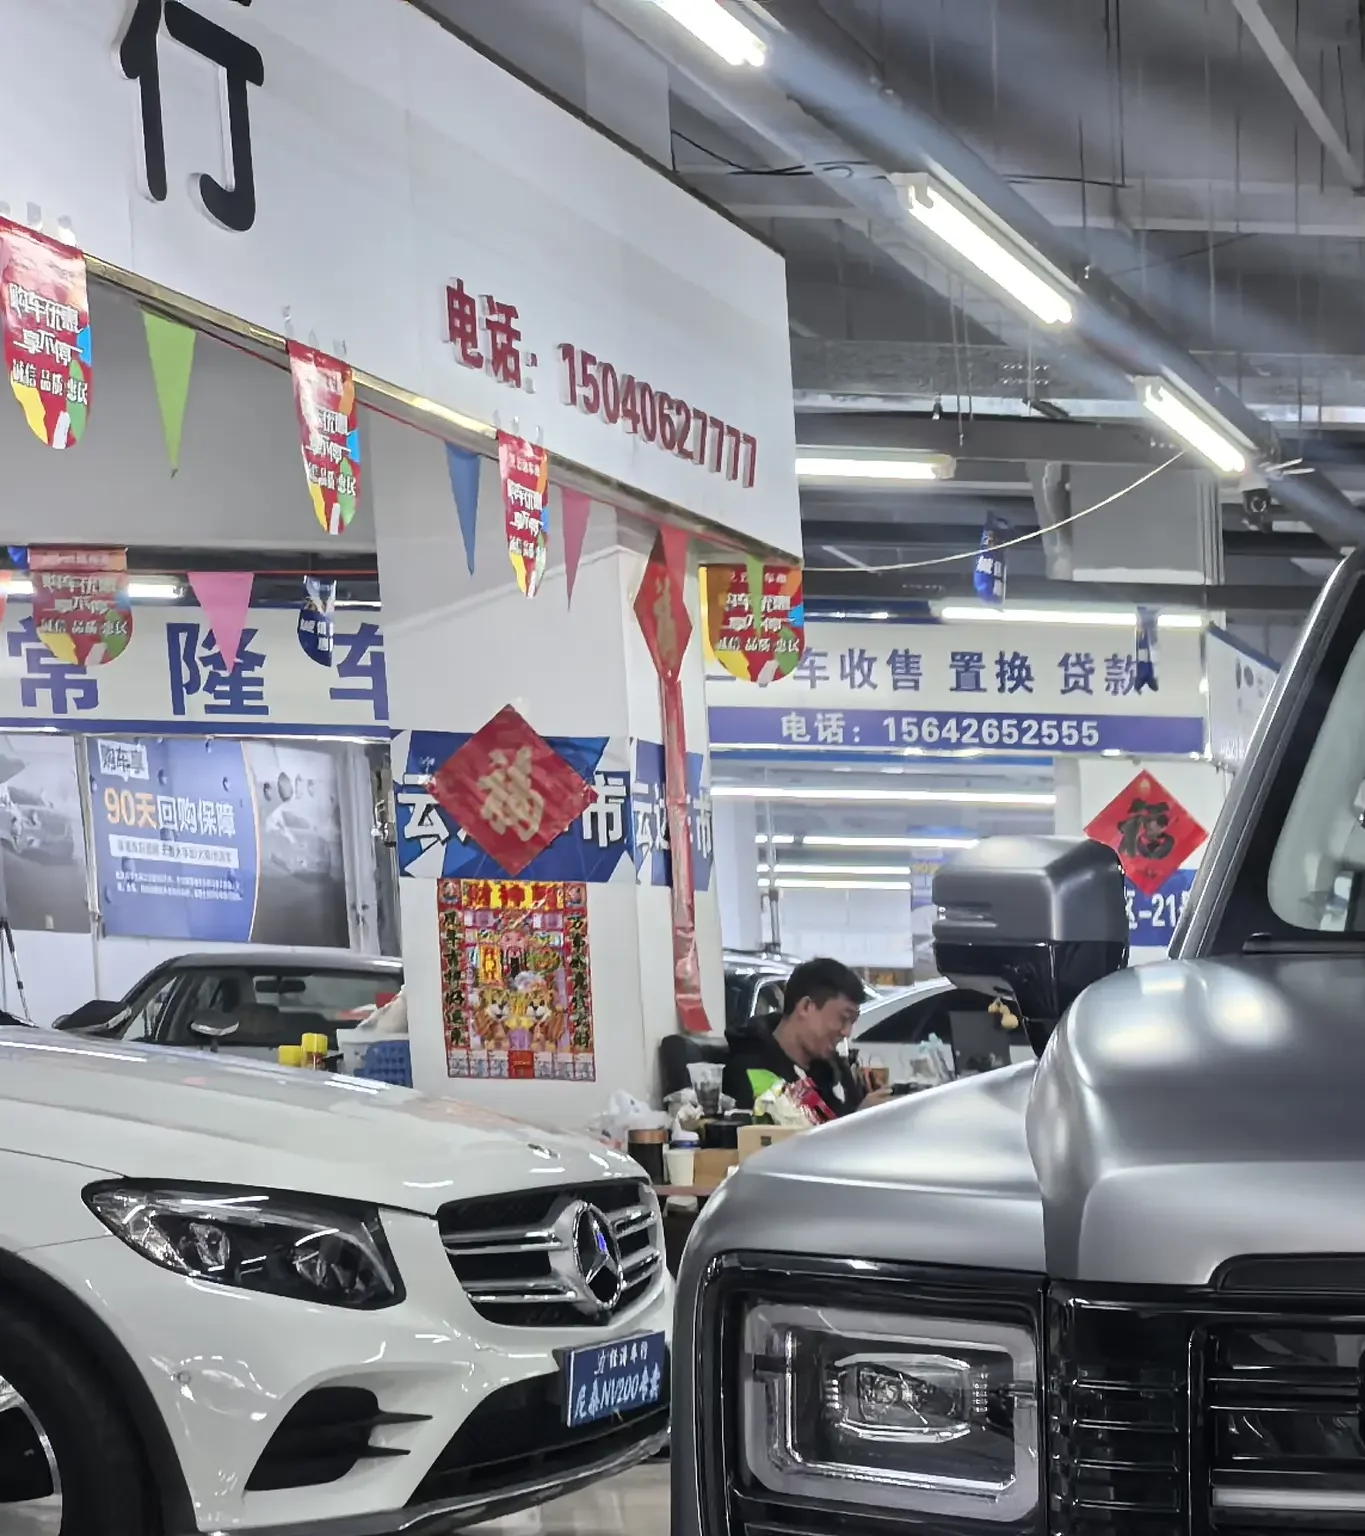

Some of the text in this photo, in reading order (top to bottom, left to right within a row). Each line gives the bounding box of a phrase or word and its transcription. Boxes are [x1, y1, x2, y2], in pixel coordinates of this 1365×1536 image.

[558, 342, 758, 489] 15040627777
[949, 650, 1034, 694] 置换
[1058, 652, 1148, 696] 贷款
[882, 714, 1099, 747] 15642652555
[103, 786, 236, 838] 90天回购保障
